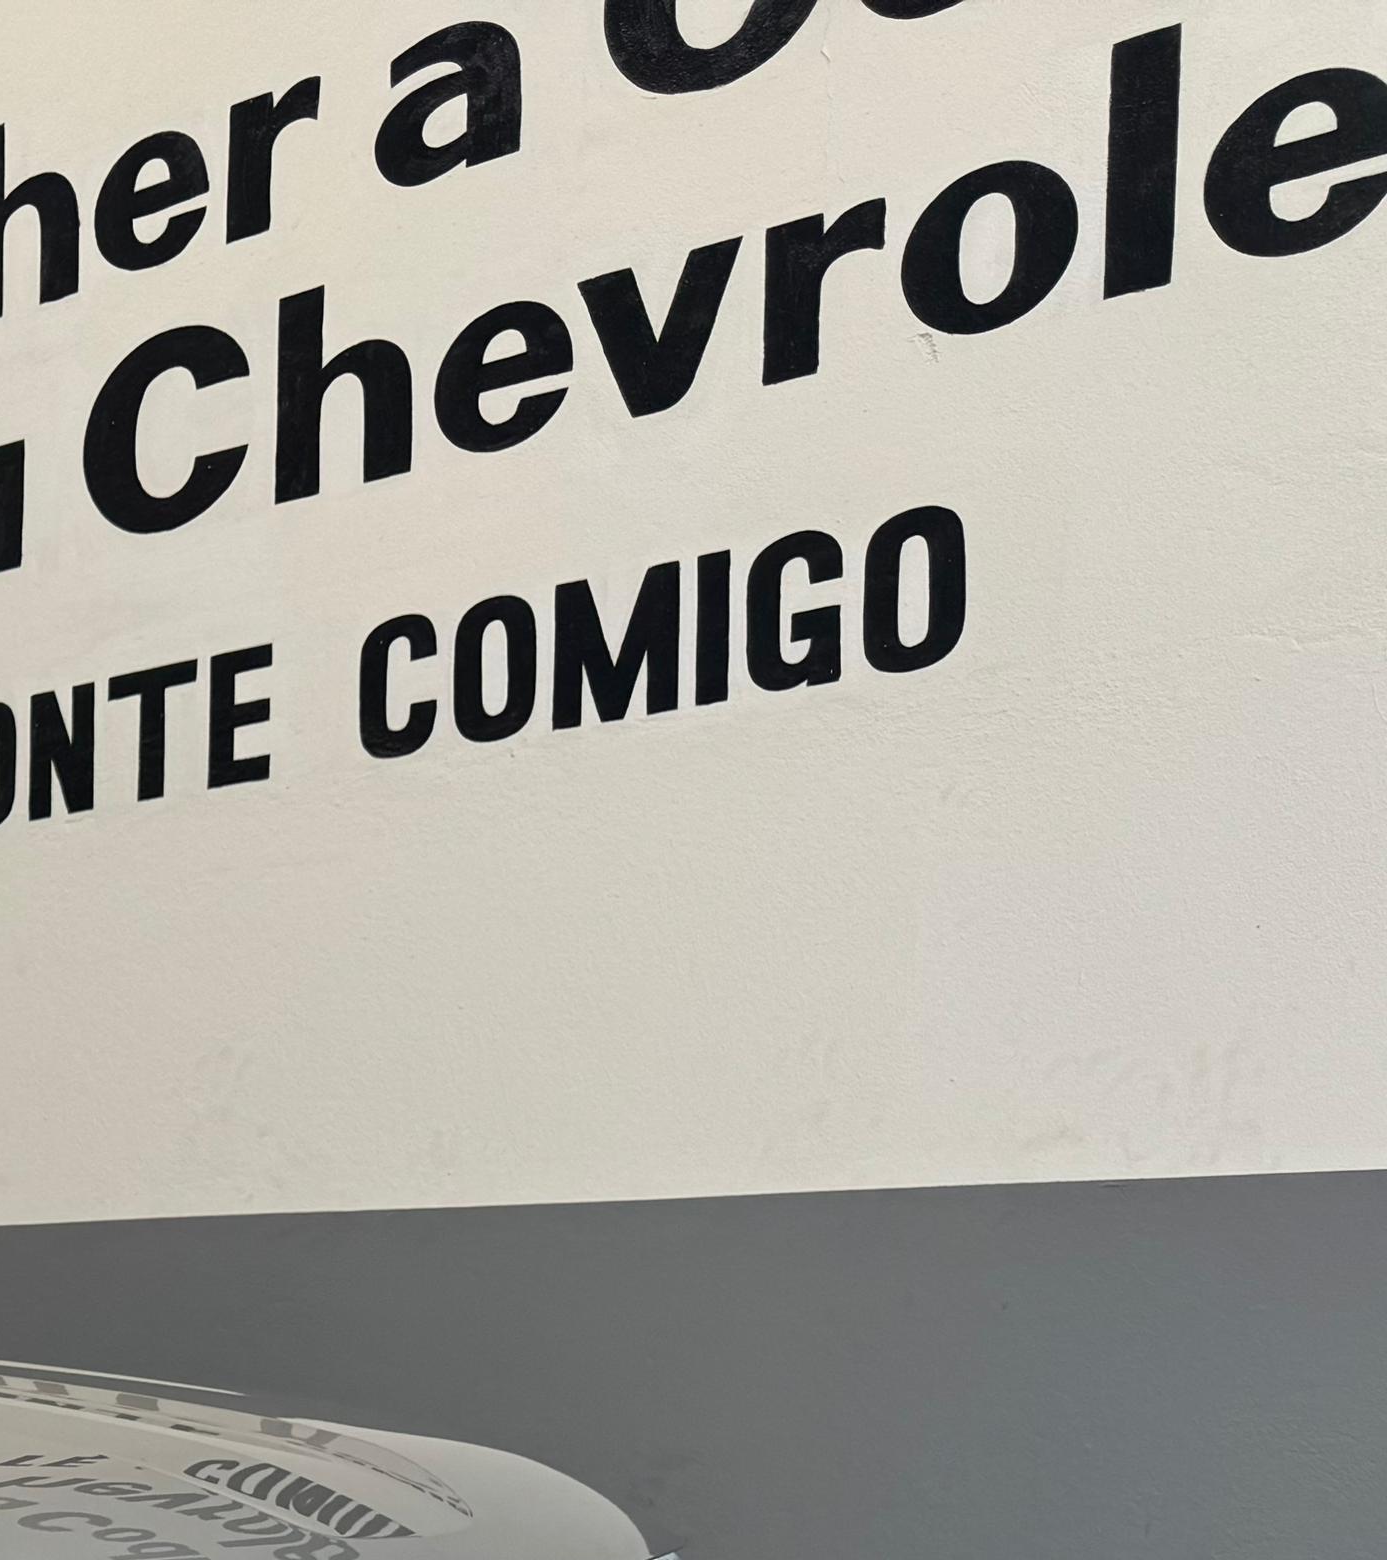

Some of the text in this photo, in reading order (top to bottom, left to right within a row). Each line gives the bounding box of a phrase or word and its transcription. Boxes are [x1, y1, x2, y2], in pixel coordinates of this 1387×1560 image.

[374, 20, 522, 187] a
[82, 22, 1387, 535] Chevrole
[359, 505, 967, 759] COMIGO
